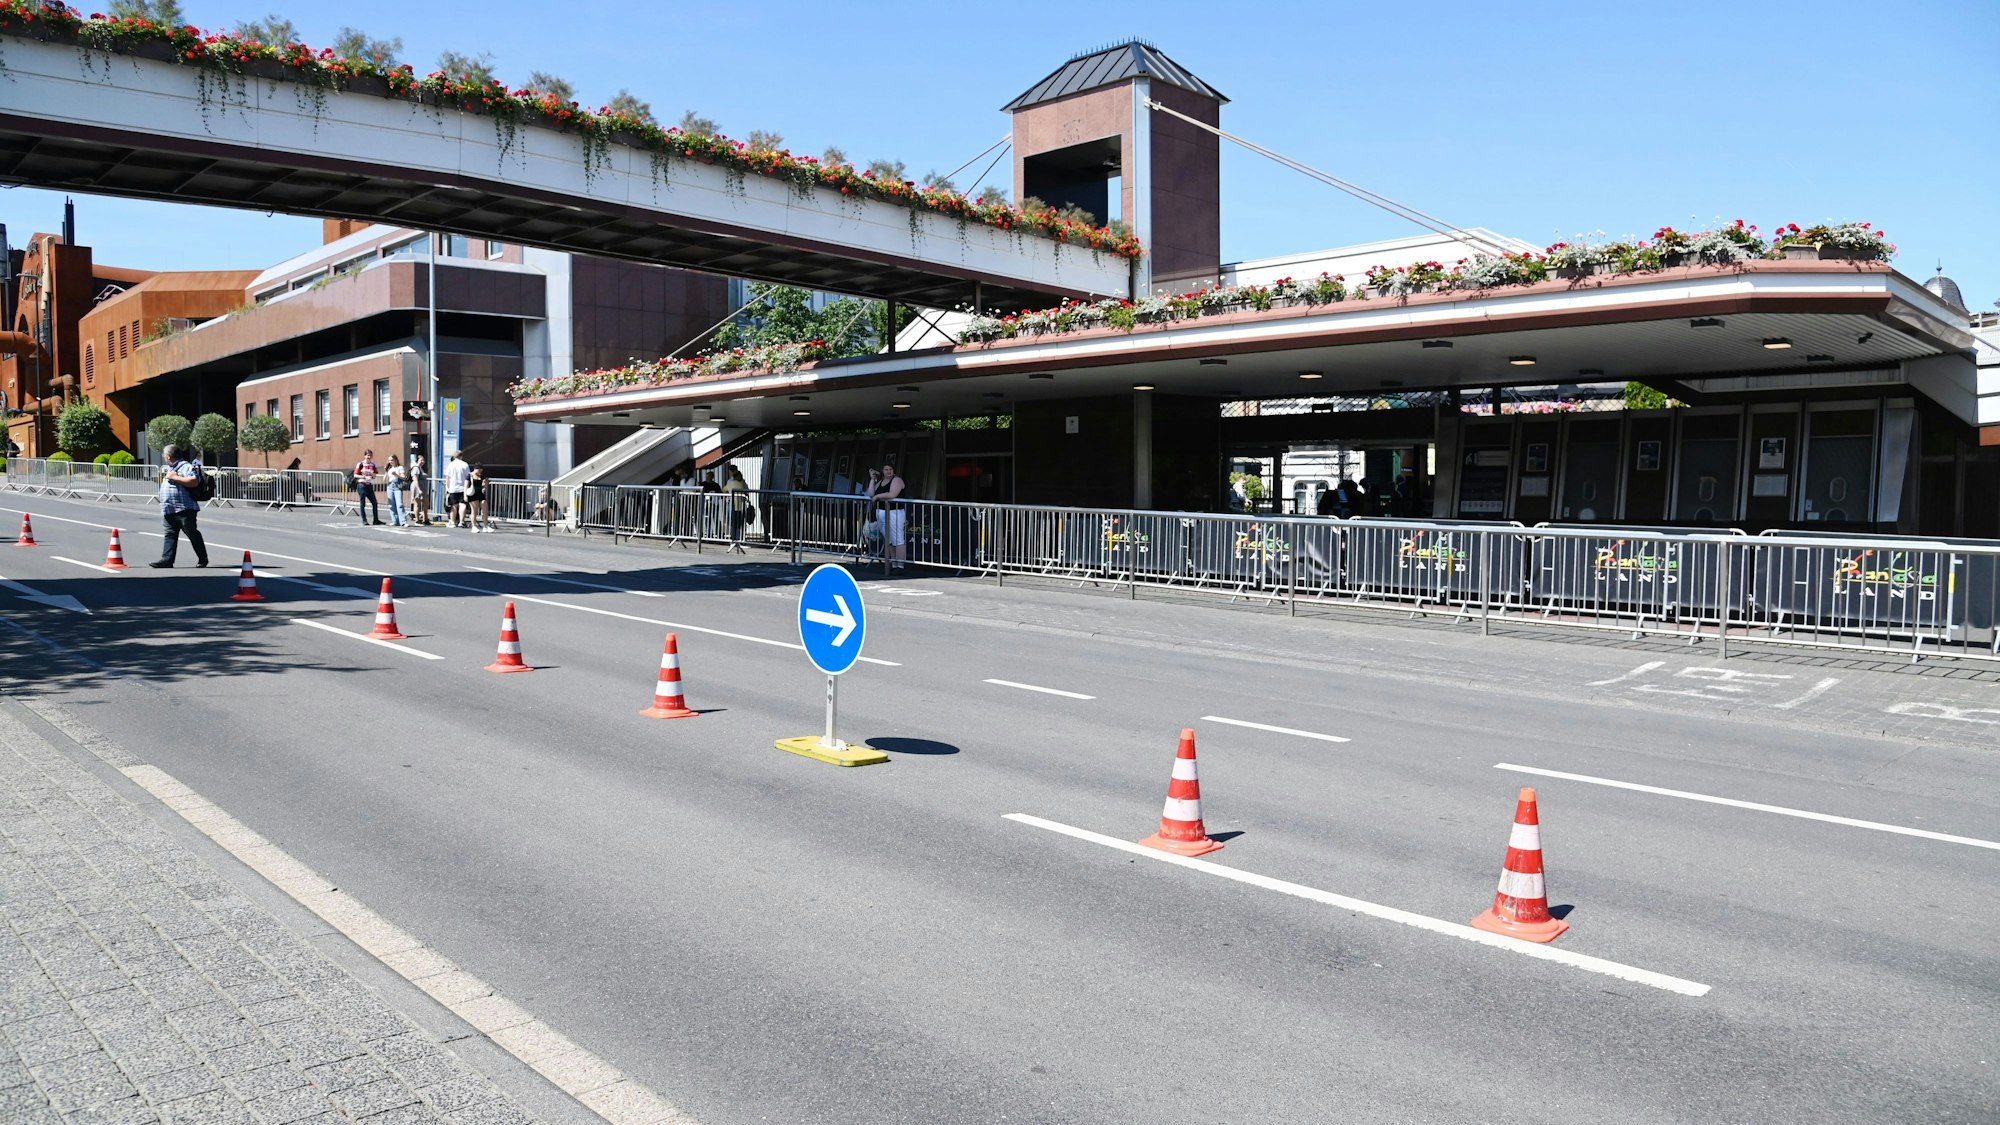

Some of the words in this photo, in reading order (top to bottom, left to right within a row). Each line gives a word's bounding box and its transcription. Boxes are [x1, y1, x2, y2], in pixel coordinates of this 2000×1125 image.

[908, 537, 942, 546] AND
[1400, 560, 1466, 572] LAND
[1595, 570, 1678, 584] LAND
